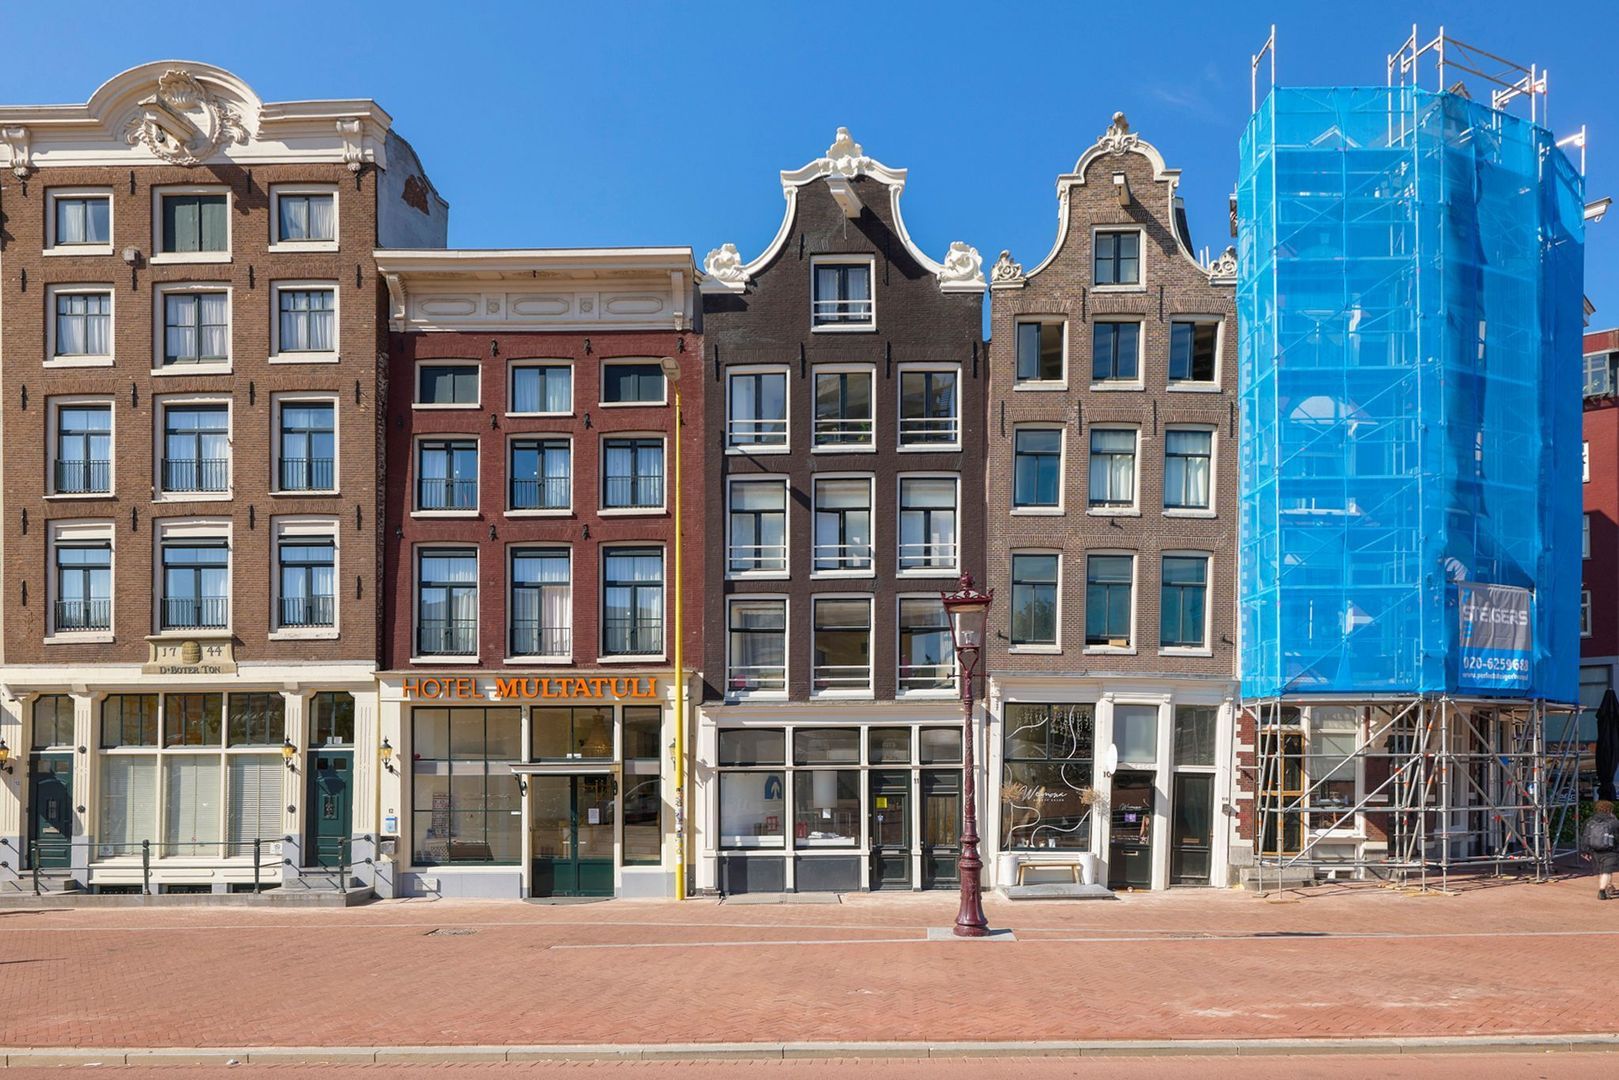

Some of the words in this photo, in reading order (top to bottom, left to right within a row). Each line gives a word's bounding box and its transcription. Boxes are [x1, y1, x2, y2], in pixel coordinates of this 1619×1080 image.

[1462, 605, 1528, 625] STEIGERS
[162, 647, 177, 657] 17
[206, 646, 222, 657] 44
[201, 665, 221, 674] TON
[401, 677, 486, 698] HOTEL
[494, 677, 658, 698] MULTATULI
